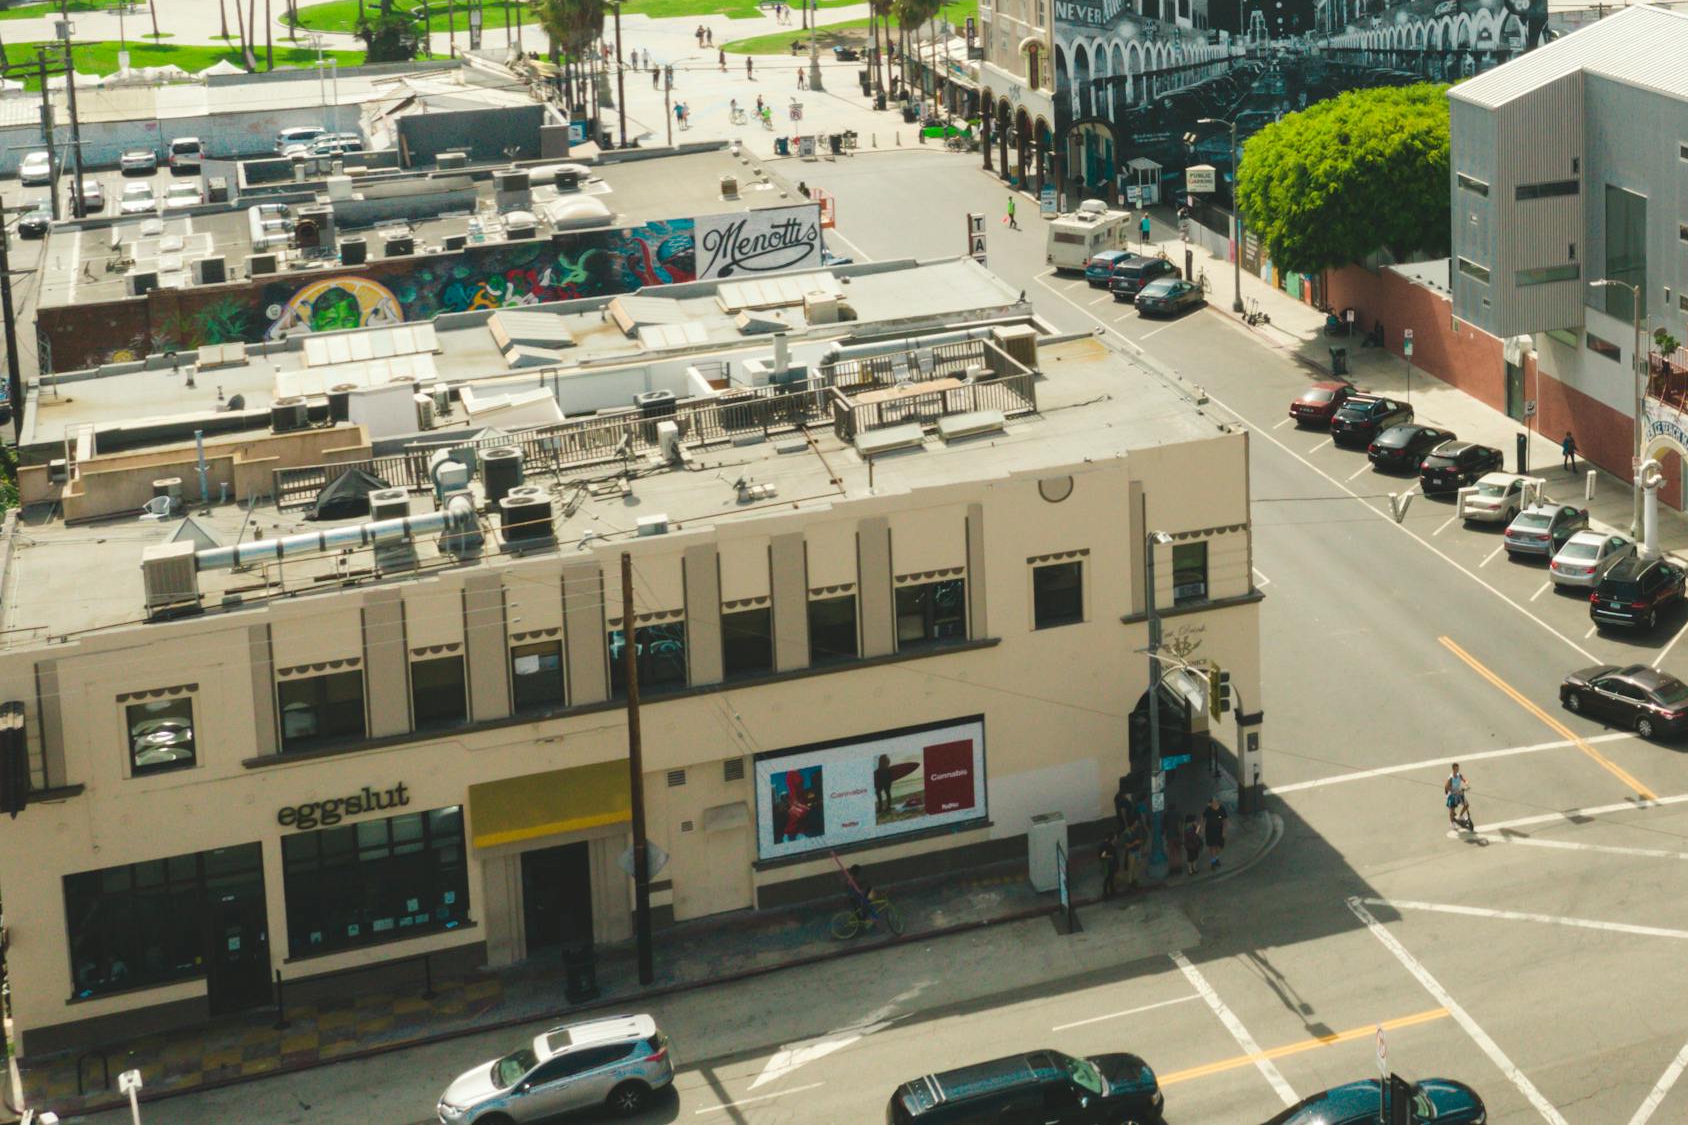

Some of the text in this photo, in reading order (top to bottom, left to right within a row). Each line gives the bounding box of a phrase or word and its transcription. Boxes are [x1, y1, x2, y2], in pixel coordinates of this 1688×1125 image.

[1056, 1, 1102, 24] NEVER
[931, 768, 968, 781] Cannabis
[830, 787, 868, 799] Cannabis
[277, 780, 410, 830] eggslut
